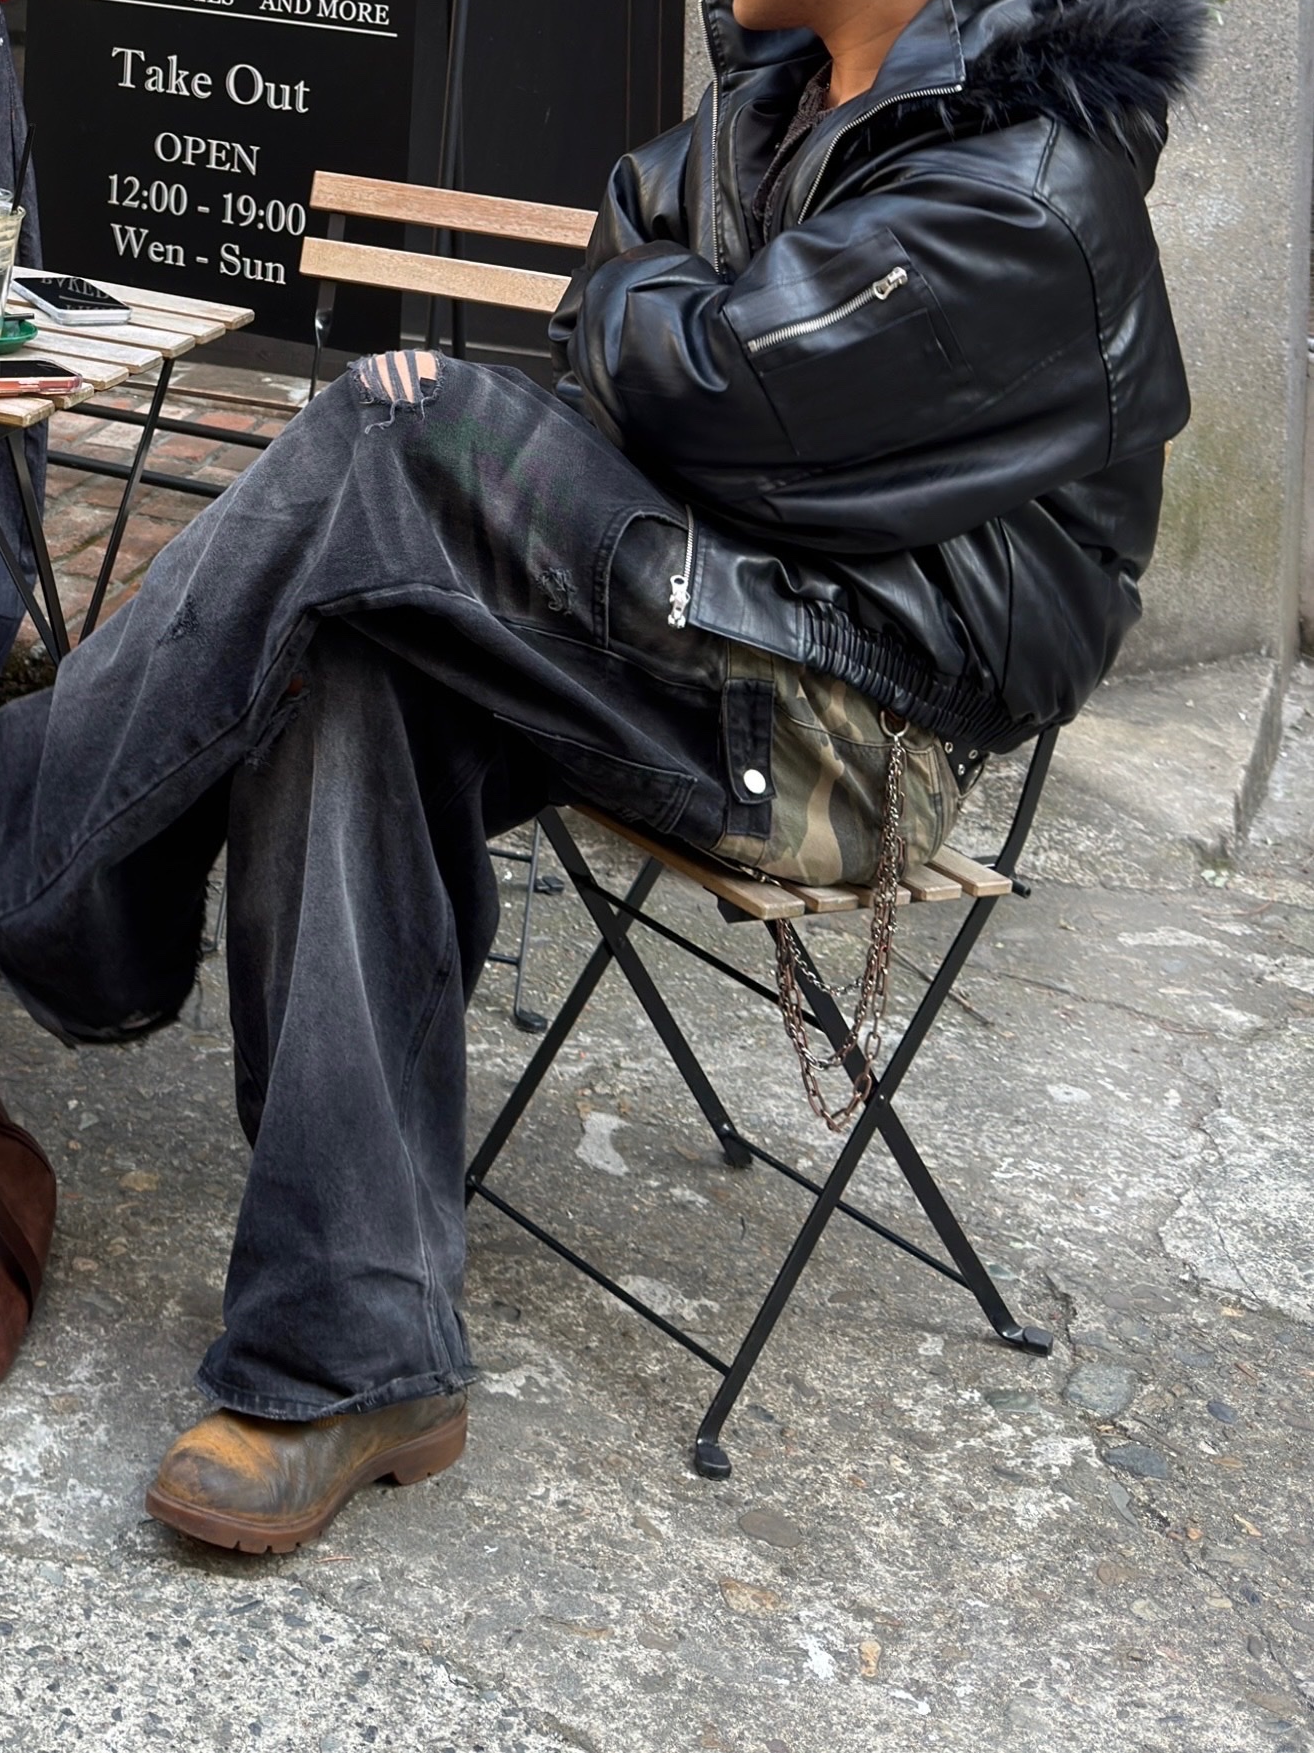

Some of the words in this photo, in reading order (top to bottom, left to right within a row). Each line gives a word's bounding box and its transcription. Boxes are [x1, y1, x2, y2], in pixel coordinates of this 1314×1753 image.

[317, 0, 390, 25] MORE
[112, 47, 212, 99] Take
[226, 63, 310, 113] Out
[154, 132, 260, 176] OPEN
[107, 174, 187, 216] 12:00
[222, 192, 306, 236] 19:00
[110, 223, 186, 267] Wen
[219, 243, 286, 285] Sun
